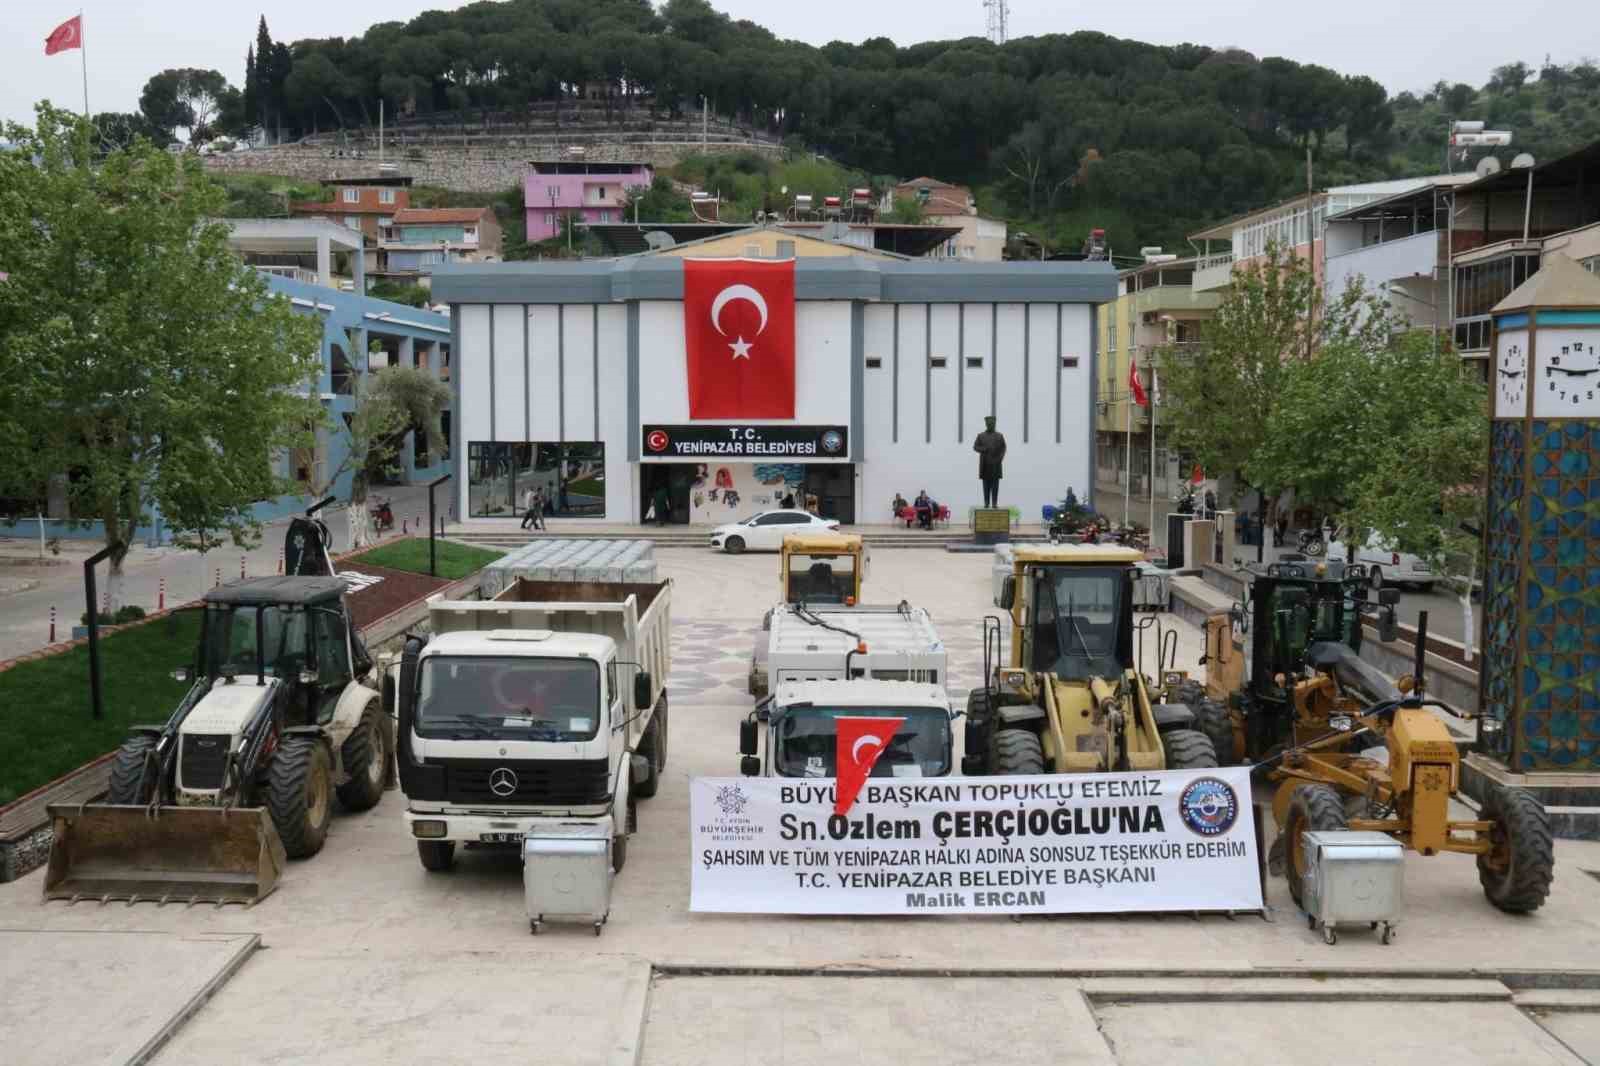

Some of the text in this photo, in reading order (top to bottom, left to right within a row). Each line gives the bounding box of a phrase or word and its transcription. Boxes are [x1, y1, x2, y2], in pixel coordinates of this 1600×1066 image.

[729, 428, 762, 440] T.C.
[675, 439, 817, 454] YENİPAZAR BELEDİYESİ
[867, 785, 961, 808] BAŞKAN
[968, 783, 1073, 801] TOPUKLU
[1081, 775, 1163, 798] EFEMİZ
[932, 800, 1166, 847] ÇERÇİOĞLU'NA
[703, 838, 1247, 870] ŞAHSIM VE TÜM YENİPAZAR HALKI ADINA SONSUZ TEŞEKKÜR EDERİM
[795, 866, 1156, 888] T.C. YENİPAZAR BELEDİYE BAŞKANI
[905, 891, 1046, 908] Malik ERCAN
